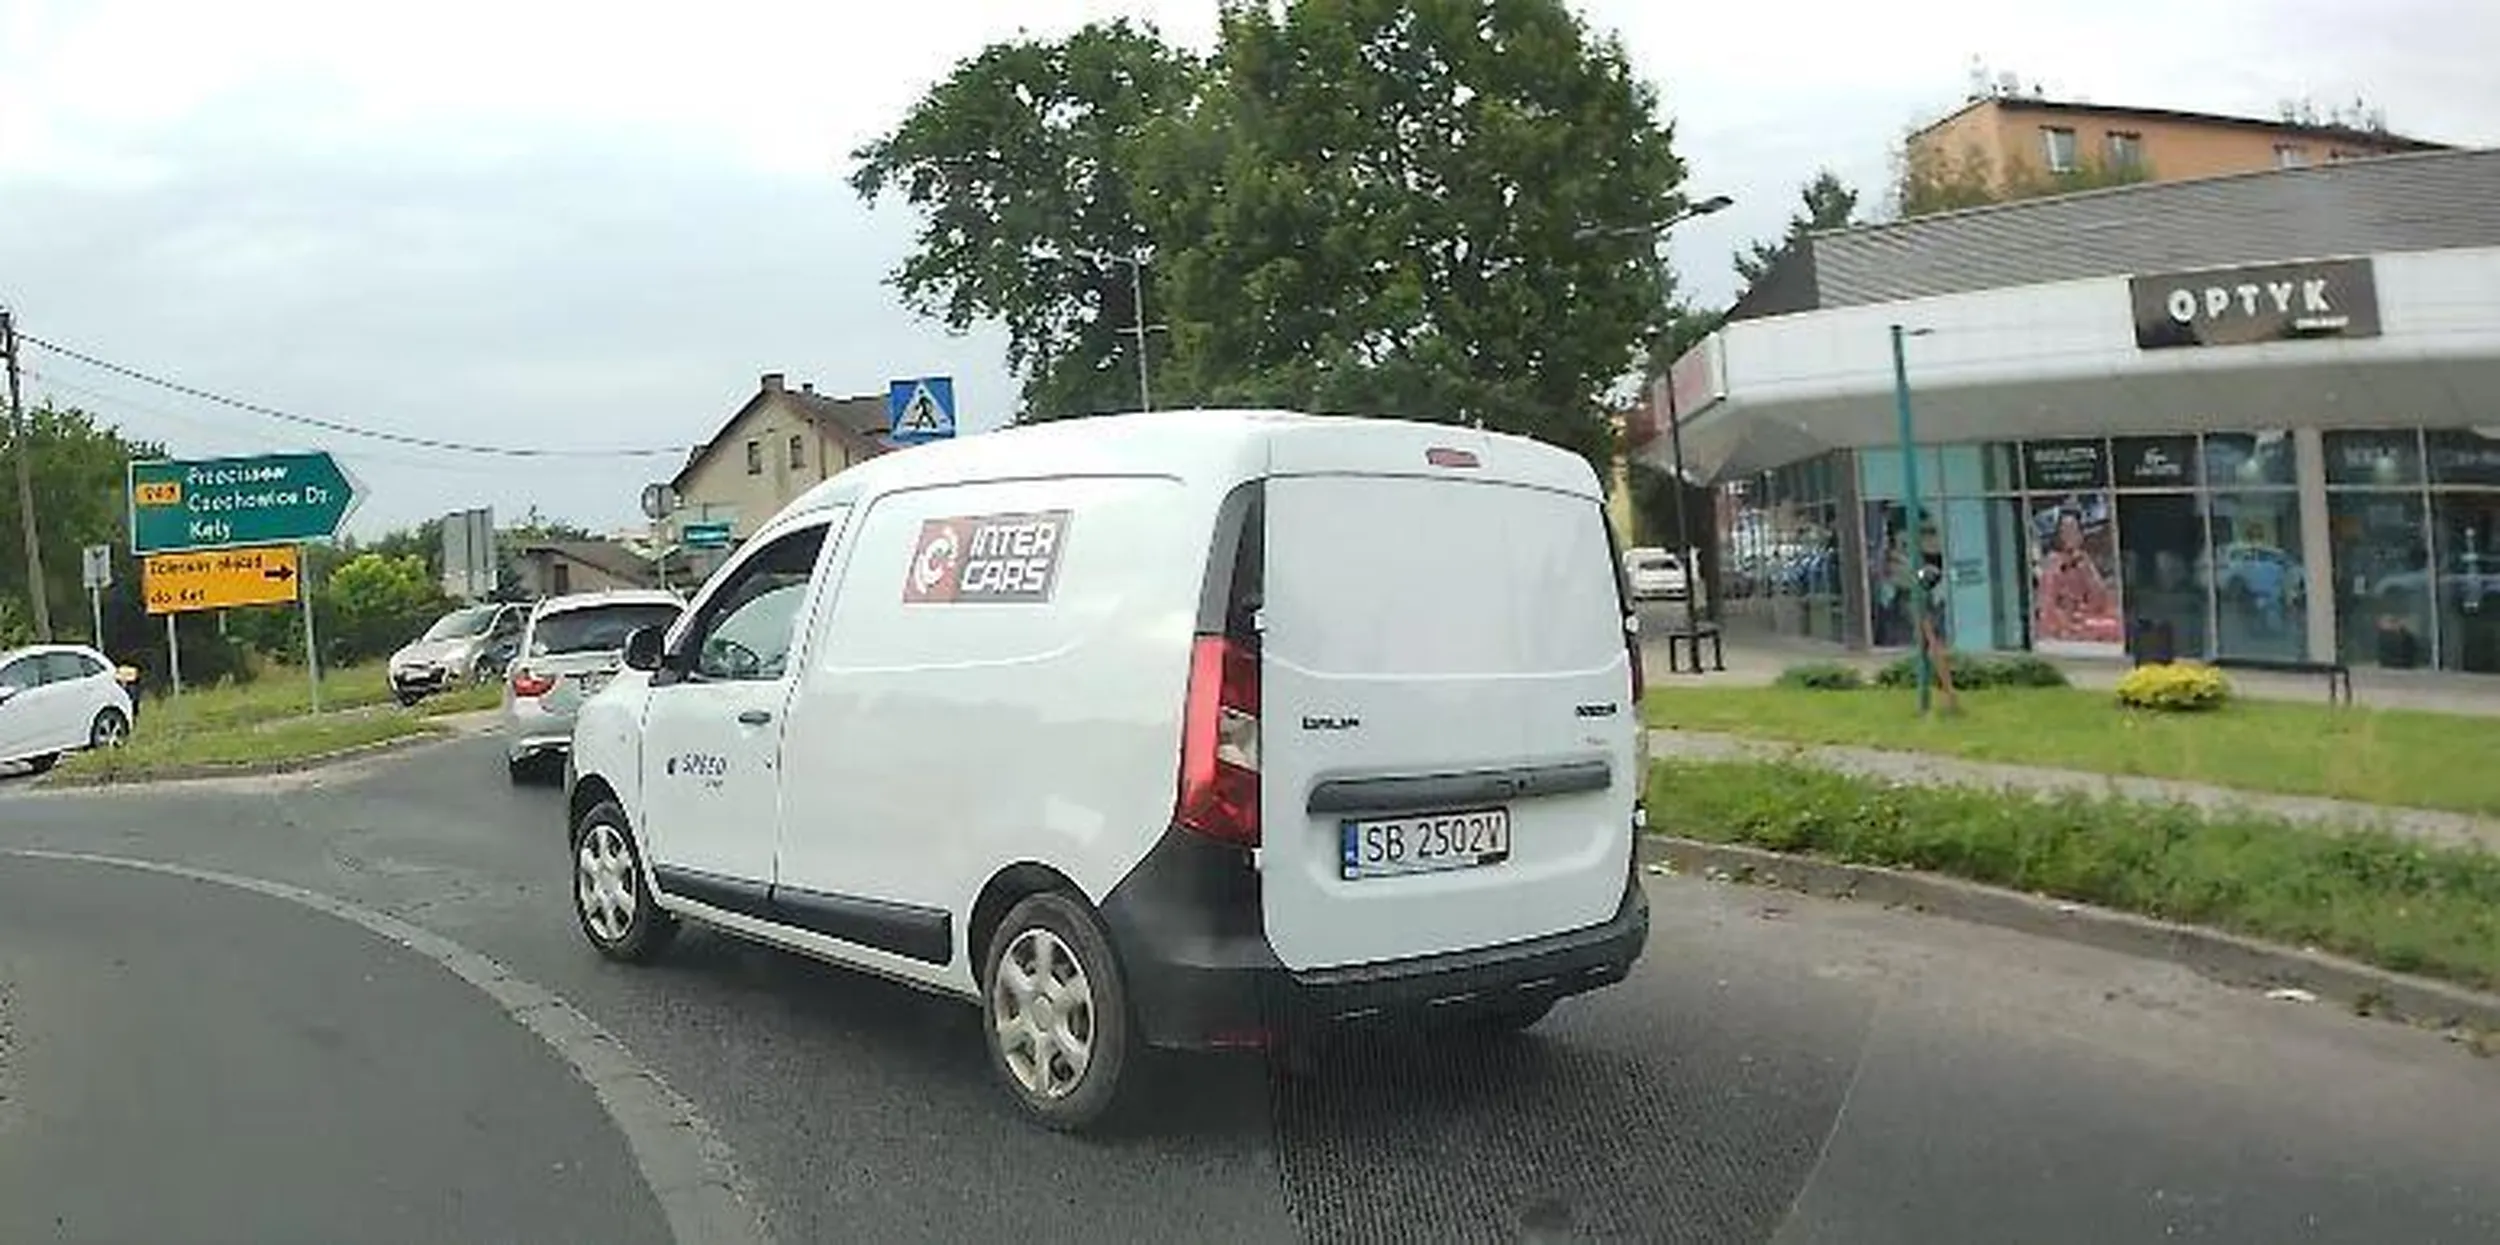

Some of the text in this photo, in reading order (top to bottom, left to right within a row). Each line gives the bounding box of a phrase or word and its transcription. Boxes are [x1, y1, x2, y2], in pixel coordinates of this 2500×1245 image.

[2168, 279, 2330, 322] OPTYK
[970, 521, 1056, 558] INTER
[961, 559, 1049, 590] CARS
[1366, 825, 1405, 862] SB
